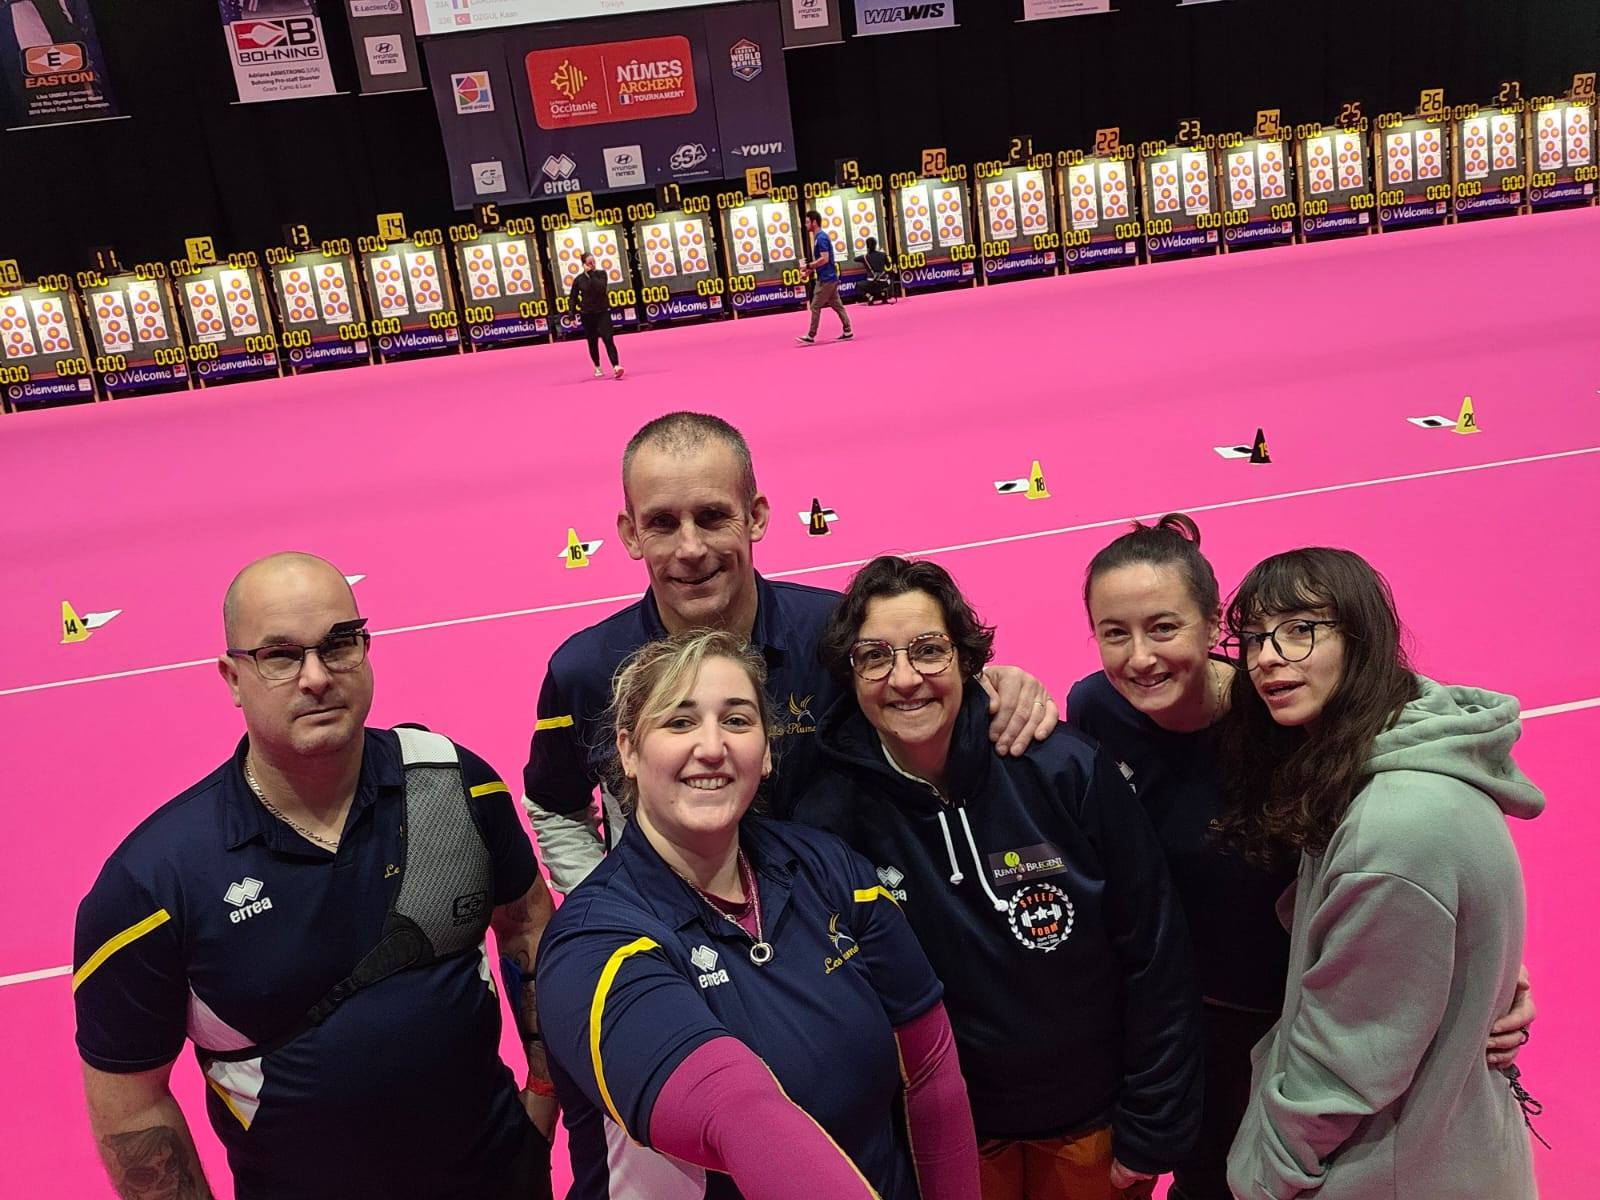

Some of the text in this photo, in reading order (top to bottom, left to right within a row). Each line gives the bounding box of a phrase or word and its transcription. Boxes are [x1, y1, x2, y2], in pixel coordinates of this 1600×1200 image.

[865, 2, 945, 24] WIAWIS
[240, 46, 320, 63] BOHNING
[730, 51, 760, 62] WORLD
[616, 59, 682, 82] NÎMES
[732, 59, 762, 68] SERIES
[25, 71, 94, 88] EASTON
[619, 77, 683, 94] ARCHERY
[1574, 76, 1594, 96] 28
[634, 90, 686, 102] TOURNAMENT
[1500, 82, 1520, 102] 27
[550, 102, 598, 114] Occitanie
[1422, 93, 1442, 112] 26
[1340, 102, 1360, 123] 25
[1178, 120, 1200, 141] 23
[1258, 113, 1278, 134] 24
[741, 142, 783, 156] YOUYI
[1010, 138, 1033, 158] 21
[1096, 131, 1118, 151] 22
[842, 160, 860, 180] 19
[924, 152, 945, 172] 20
[754, 171, 770, 192] 18
[1502, 174, 1525, 191] 000
[1533, 172, 1556, 188] 000
[1575, 166, 1598, 182] 000
[544, 178, 580, 194] errea
[664, 184, 680, 204] 17
[1427, 184, 1450, 200] 000
[1458, 182, 1481, 197] 000
[1543, 185, 1582, 199] Bienvenue
[576, 196, 592, 216] 16
[1350, 194, 1374, 210] 000
[1380, 190, 1404, 206] 000
[1468, 195, 1510, 209] Bienvenido
[481, 204, 500, 225] 15
[1271, 203, 1296, 220] 000
[1304, 200, 1328, 216] 000
[1393, 205, 1434, 220] Welcome
[1196, 212, 1222, 229] 000
[1224, 209, 1248, 226] 000
[1316, 216, 1356, 229] Bienvenue
[292, 225, 310, 246] 13
[384, 218, 403, 236] 14
[1116, 222, 1140, 240] 000
[1147, 219, 1172, 235] 000
[1236, 225, 1282, 238] Bienvenido
[1034, 232, 1059, 250] 000
[1065, 229, 1090, 246] 000
[1162, 235, 1206, 249] Welcome
[194, 240, 212, 262] 12
[951, 244, 976, 262] 000
[984, 240, 1010, 258] 000
[1080, 245, 1123, 259] Bienvenue
[97, 250, 118, 269] 11
[900, 252, 925, 270] 000
[997, 255, 1044, 269] Bienvenido
[915, 267, 960, 282] Welcome
[697, 278, 724, 296] 000
[729, 275, 756, 292] 000
[608, 290, 636, 307] 000
[642, 286, 670, 303] 000
[746, 288, 794, 303] Bienvenido
[466, 306, 494, 324] 000
[520, 300, 548, 318] 000
[661, 301, 708, 315] Welcome
[372, 318, 400, 336] 000
[429, 311, 458, 328] 000
[339, 322, 368, 340] 000
[483, 321, 534, 336] Bienvenido
[246, 334, 274, 352] 000
[282, 330, 311, 348] 000
[394, 333, 444, 348] Welcome
[154, 347, 184, 366] 000
[189, 342, 218, 361] 000
[306, 344, 353, 358] Bienvenue
[56, 358, 87, 376] 000
[97, 355, 126, 373] 000
[211, 356, 263, 372] Bienvenido
[120, 368, 172, 383] Welcome
[24, 381, 76, 396] Bienvenue
[1034, 477, 1045, 492] 18
[812, 512, 825, 528] 17
[570, 545, 582, 560] 16
[64, 619, 78, 634] 14
[384, 864, 400, 878] Le
[1026, 858, 1063, 872] BREGENT
[1019, 892, 1055, 908] SPEED
[229, 896, 272, 924] errea
[1031, 921, 1058, 936] FORM
